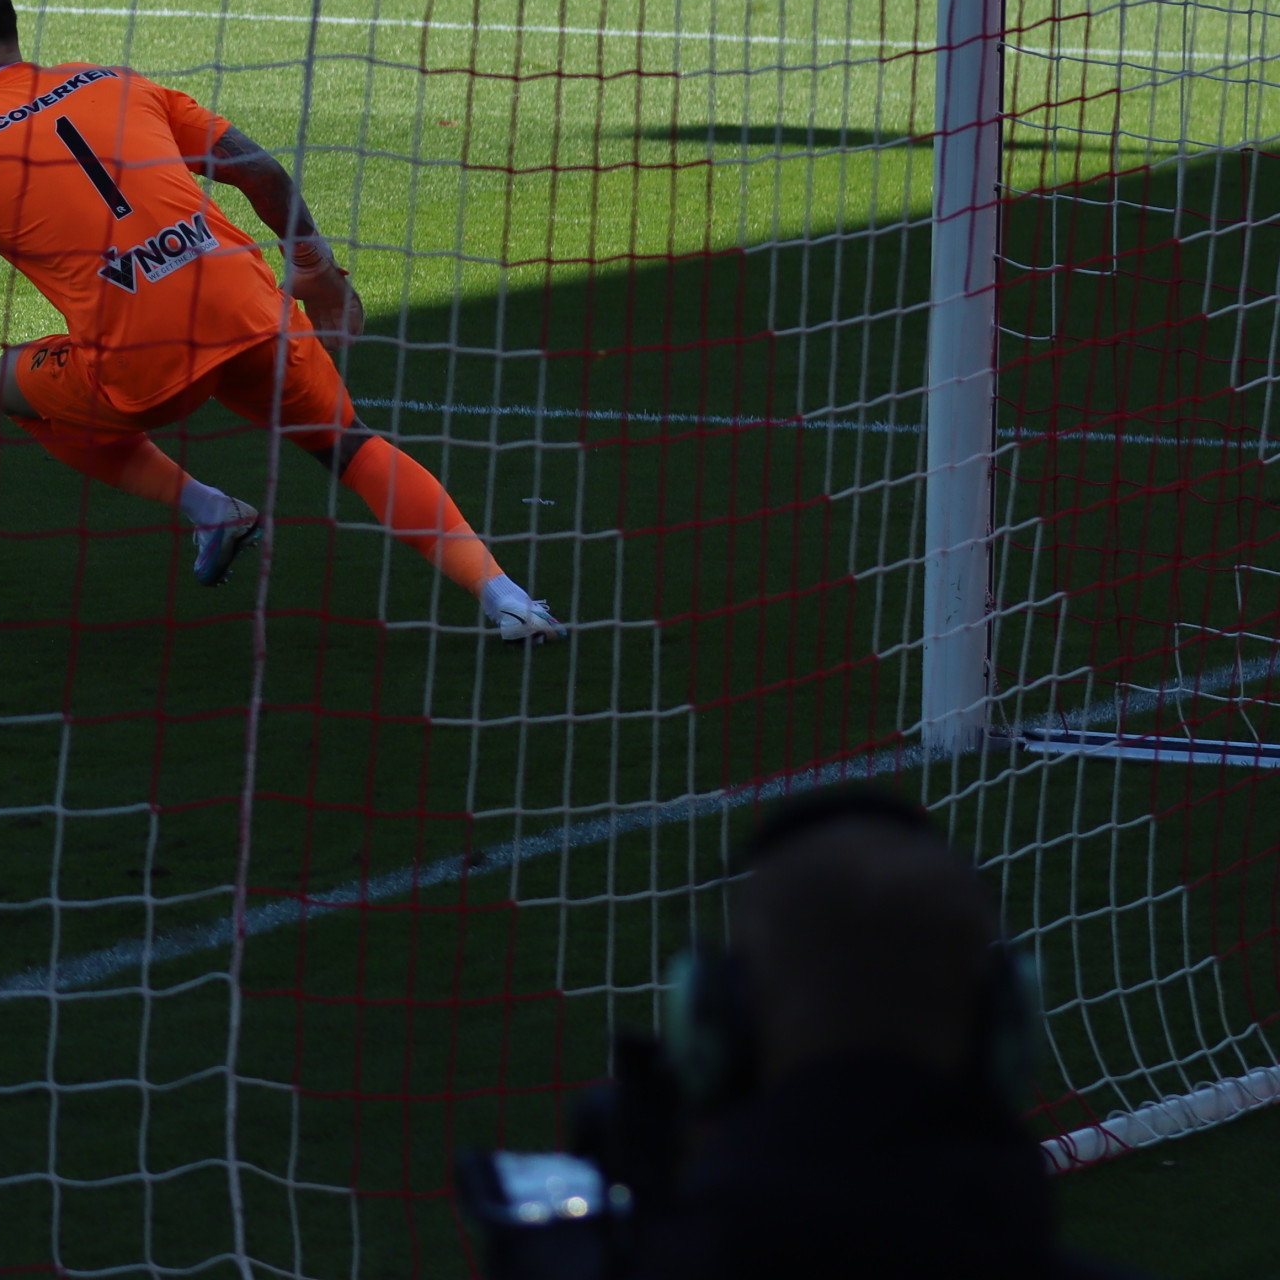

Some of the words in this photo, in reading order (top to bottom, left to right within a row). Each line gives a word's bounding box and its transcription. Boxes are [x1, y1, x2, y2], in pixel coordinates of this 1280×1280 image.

[55, 115, 134, 220] 1
[148, 270, 160, 281] WE
[160, 263, 174, 274] GET
